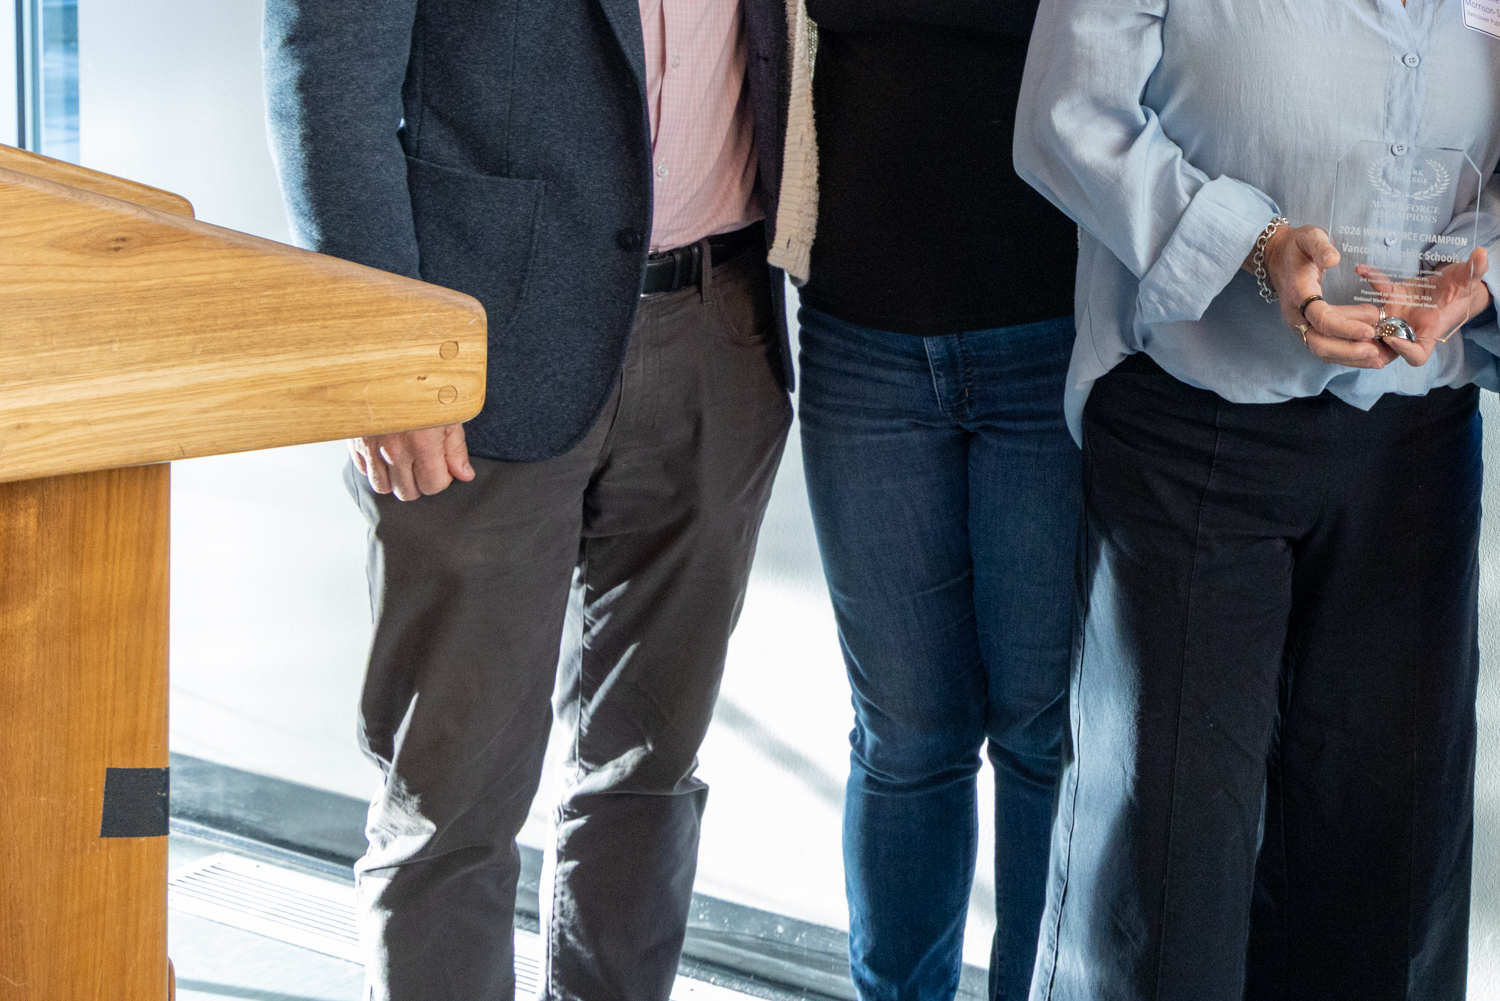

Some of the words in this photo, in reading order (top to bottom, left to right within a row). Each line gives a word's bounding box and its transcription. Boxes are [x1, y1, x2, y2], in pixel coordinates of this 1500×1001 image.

[1373, 200, 1440, 214] WORKFORCE
[1338, 225, 1361, 236] 2026
[1419, 233, 1468, 247] CHAMPION
[1394, 248, 1422, 260] ublic
[1424, 250, 1460, 264] Schools
